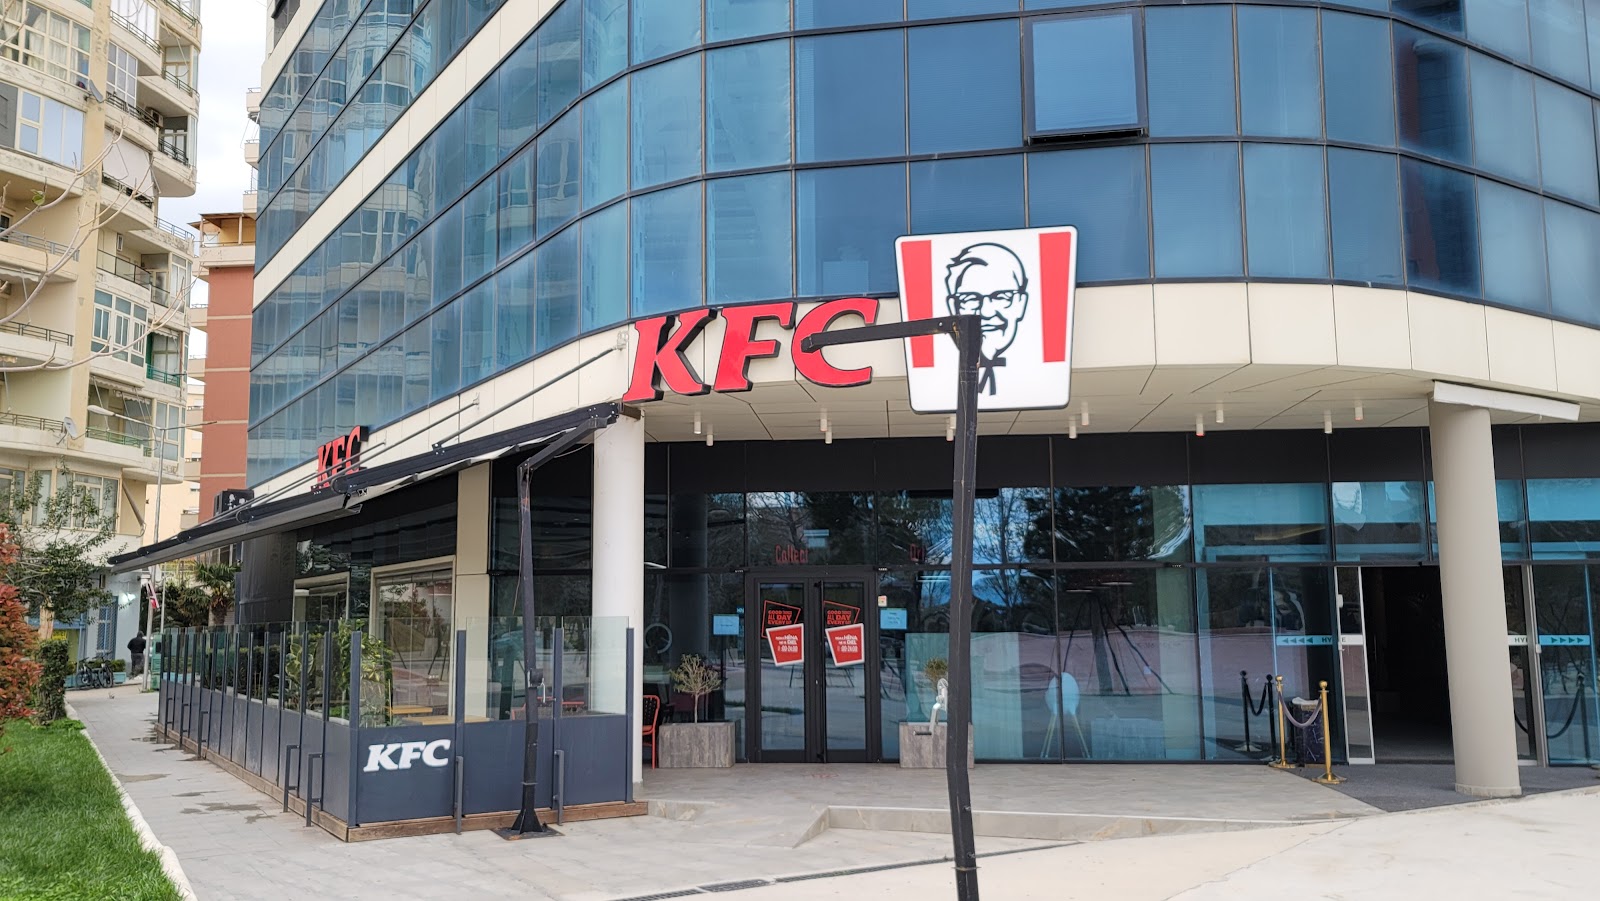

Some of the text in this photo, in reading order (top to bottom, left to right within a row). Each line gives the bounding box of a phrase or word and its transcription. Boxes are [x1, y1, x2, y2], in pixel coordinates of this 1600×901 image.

[622, 297, 879, 402] KFC
[316, 425, 361, 488] KFC
[775, 544, 809, 563] Collect
[363, 739, 451, 772] KFC
